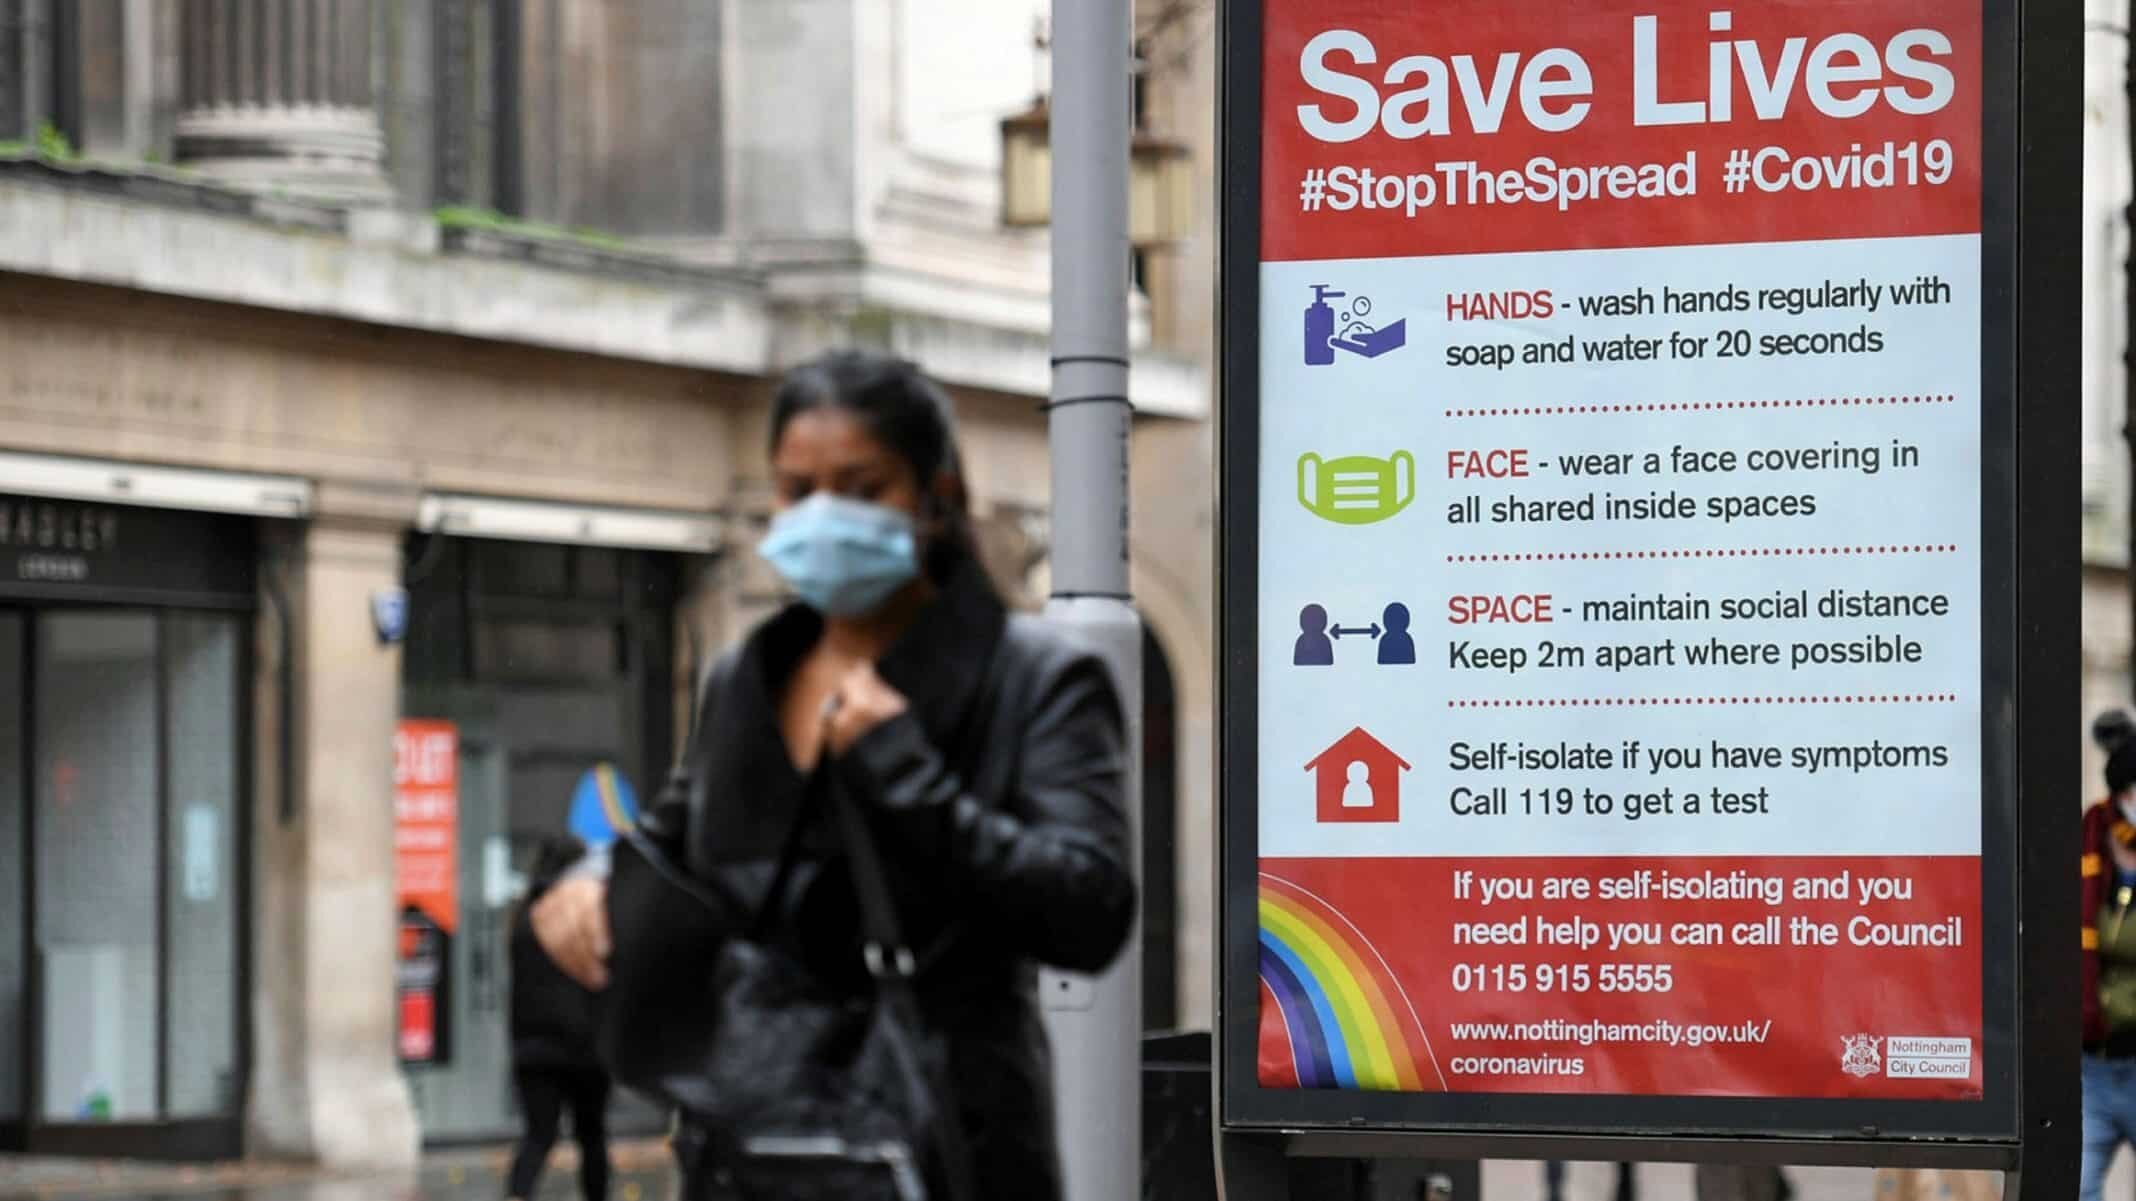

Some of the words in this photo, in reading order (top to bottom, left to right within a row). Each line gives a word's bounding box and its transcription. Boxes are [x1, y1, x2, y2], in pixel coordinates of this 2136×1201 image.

[1296, 29, 1593, 143] Save
[1633, 10, 1955, 127] Lives
[1299, 150, 1697, 218] #StopTheSpread
[1722, 139, 1953, 193] #Covid19
[1446, 289, 1554, 322] HANDS
[1578, 287, 1655, 317] wash
[1663, 283, 1751, 314] hands
[1758, 277, 1883, 316] regularly
[1889, 275, 1951, 306] with
[1446, 343, 1515, 371] soap
[1522, 334, 1575, 365] and
[1581, 333, 1663, 362] water
[1668, 330, 1709, 359] for
[1716, 329, 1752, 358] 20
[1759, 324, 1884, 357] seconds
[1447, 449, 1529, 479] FACE
[1558, 453, 1634, 476] wear
[1643, 453, 1660, 475] a
[1670, 444, 1737, 473] face
[1746, 440, 1880, 475] covering
[1892, 438, 1919, 468] in
[1447, 495, 1481, 524] all
[1491, 492, 1595, 523] shared
[1605, 490, 1697, 521] inside
[1706, 494, 1817, 524] spaces
[1447, 594, 1554, 625] SPACE
[1583, 591, 1710, 622] maintain
[1720, 589, 1808, 620] social
[1817, 589, 1949, 618] distance
[1449, 640, 1527, 674] Keep
[1537, 640, 1585, 668] 2m
[1595, 638, 1676, 673] apart
[1683, 636, 1781, 666] where
[1791, 634, 1923, 671] possible
[1449, 741, 1614, 771] Self-isolate
[1622, 740, 1640, 769] if
[1647, 747, 1701, 775] you
[1711, 739, 1782, 769] have
[1791, 739, 1949, 774] symptoms
[1450, 786, 1507, 816] Call
[1519, 787, 1574, 815] 119
[1583, 787, 1614, 815] to
[1623, 787, 1674, 821] get
[1682, 793, 1701, 815] a
[1709, 786, 1769, 815] test
[1454, 870, 1473, 900] If
[1479, 877, 1533, 906] you
[1541, 877, 1591, 900] are
[1598, 869, 1784, 906] self-isolating
[1792, 870, 1849, 900] and
[1857, 877, 1912, 906] you
[1453, 915, 1527, 945] need
[1536, 915, 1600, 951] help
[1607, 922, 1662, 951] you
[1670, 923, 1723, 945] can
[1731, 915, 1781, 945] call
[1789, 915, 1839, 946] the
[1847, 915, 1962, 947] Council
[1452, 963, 1527, 992] 0115
[1535, 963, 1591, 993] 915
[1598, 964, 1673, 993] 5555
[1450, 1018, 1772, 1047] www.nottinghamcity.gov.uk/
[1891, 1040, 1967, 1055] Nottingham
[1450, 1052, 1585, 1076] coronavirus
[1890, 1060, 1916, 1075] City
[1919, 1060, 1967, 1074] Council
